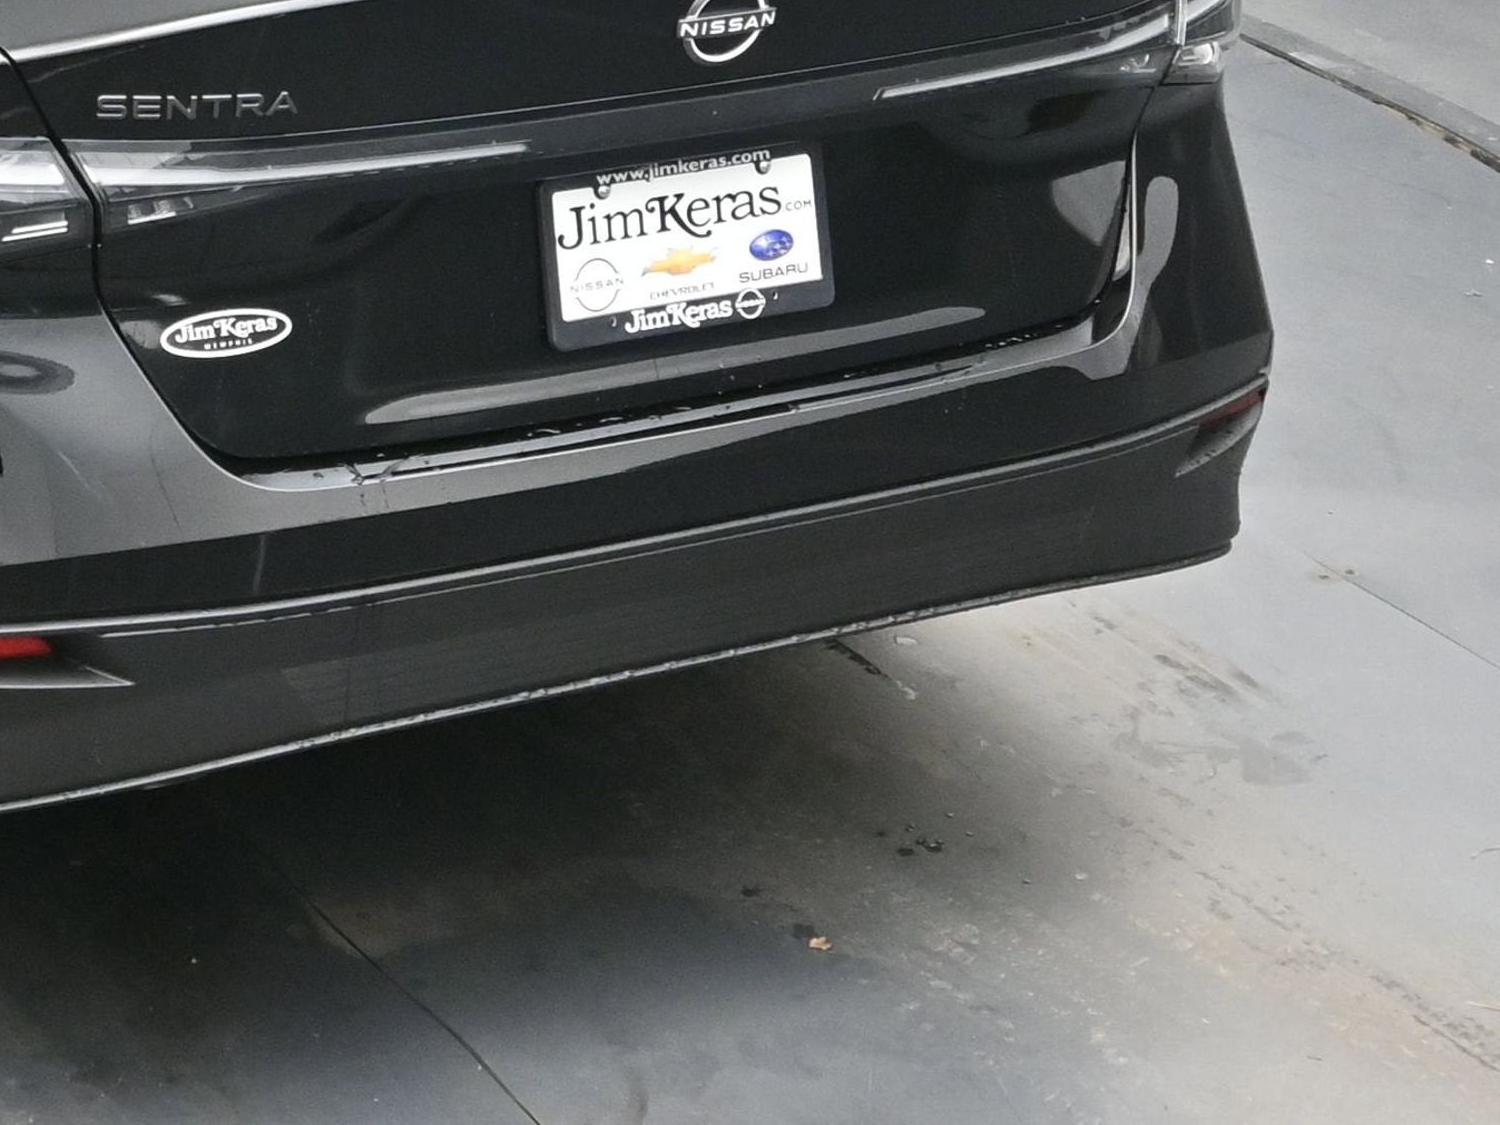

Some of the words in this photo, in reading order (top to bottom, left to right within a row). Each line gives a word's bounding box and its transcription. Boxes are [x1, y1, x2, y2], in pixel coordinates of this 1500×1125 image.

[679, 11, 776, 37] NISSAN
[96, 91, 298, 120] SENTRA
[596, 149, 771, 185] www.jimkeras.com
[739, 262, 808, 283] SUBARU
[570, 277, 624, 293] NISSAN
[649, 282, 715, 300] CHEVROLET
